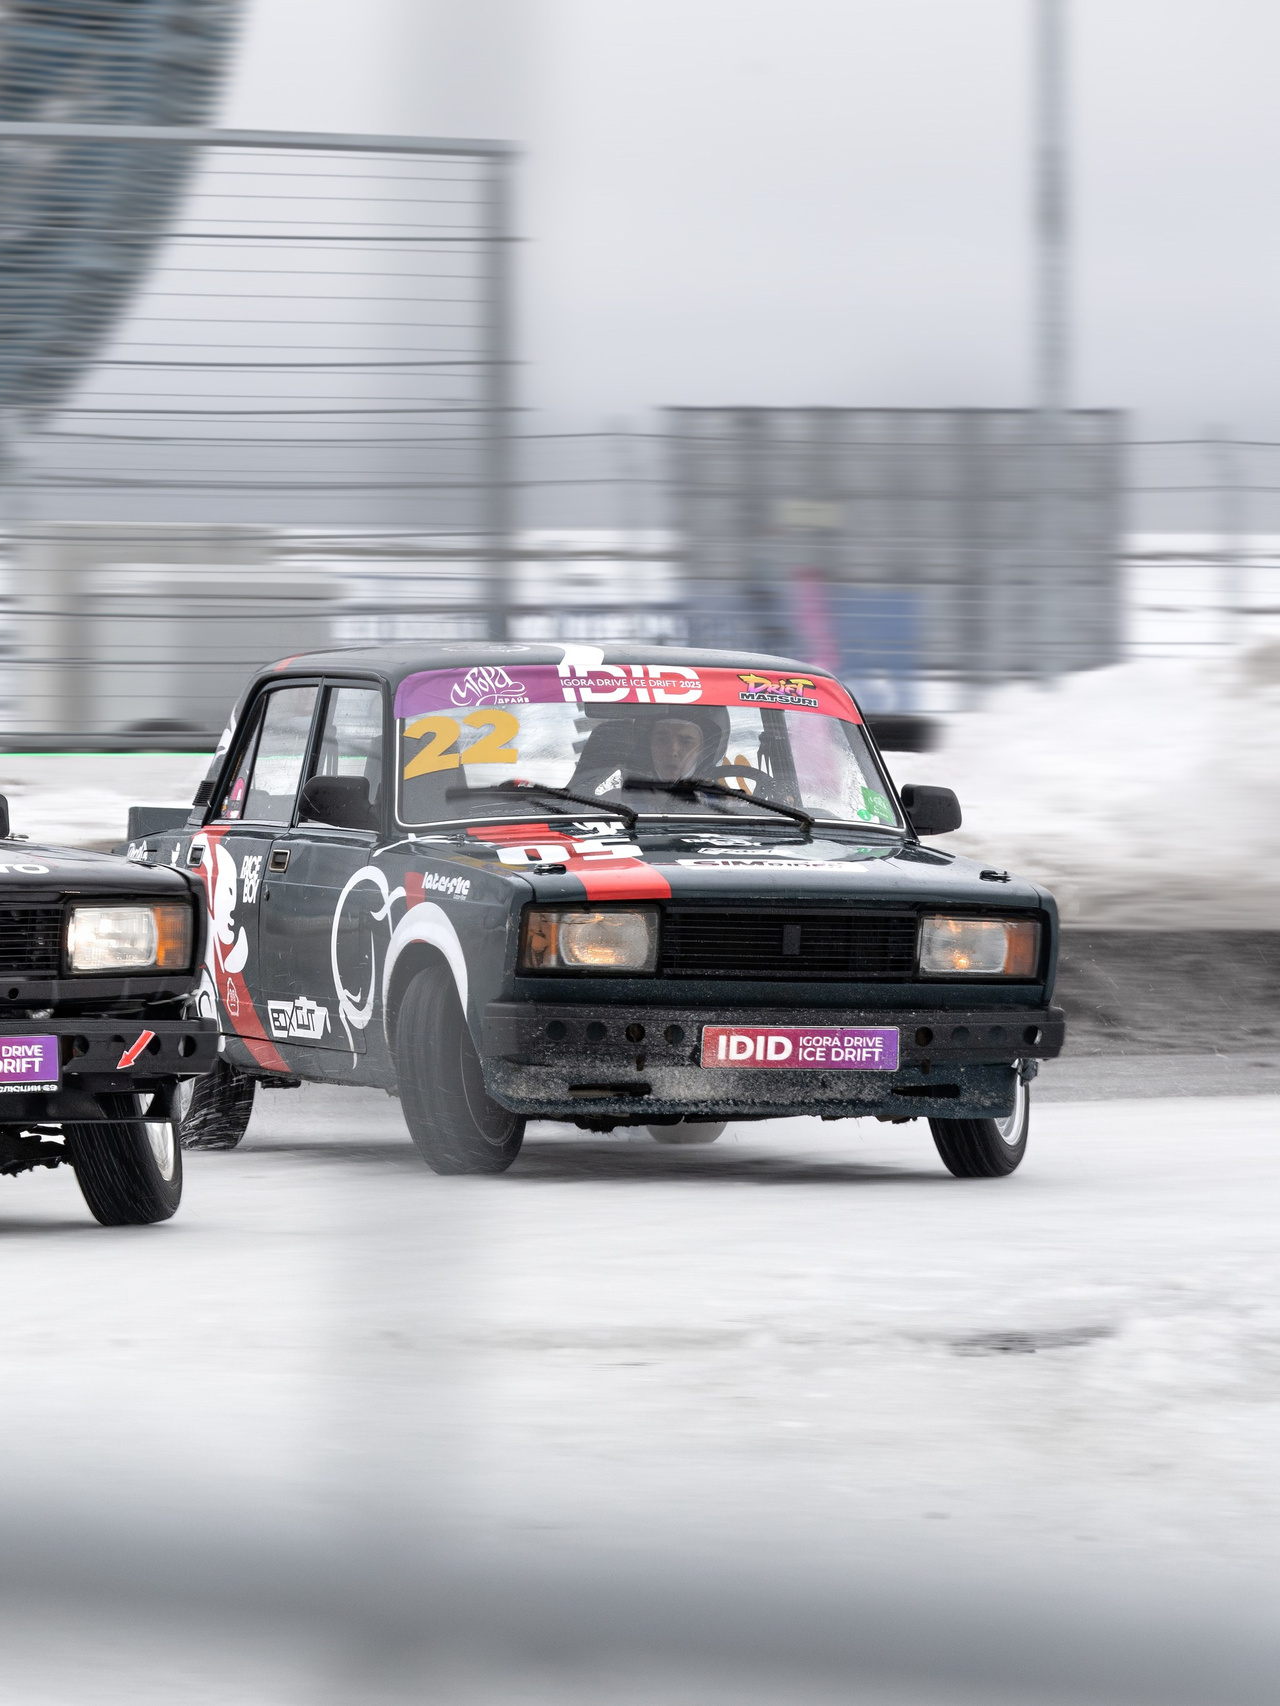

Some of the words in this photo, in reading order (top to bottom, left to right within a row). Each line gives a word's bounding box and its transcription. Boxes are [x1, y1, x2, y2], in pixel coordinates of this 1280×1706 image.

[560, 678, 595, 686] IGORA
[596, 678, 627, 687] DRIVE
[630, 679, 646, 687] ICE
[649, 679, 677, 688] DRIFT
[679, 680, 701, 688] 2025
[497, 696, 530, 704] ДРАЙВ
[739, 692, 819, 708] MATSURI
[403, 709, 520, 780] 22
[717, 1034, 793, 1061] IDID
[799, 1036, 839, 1047] IGORA
[844, 1036, 883, 1047] DRIVE
[1, 1045, 43, 1058] DRIVE
[798, 1048, 827, 1061] ICE
[831, 1048, 883, 1062] DRIFT
